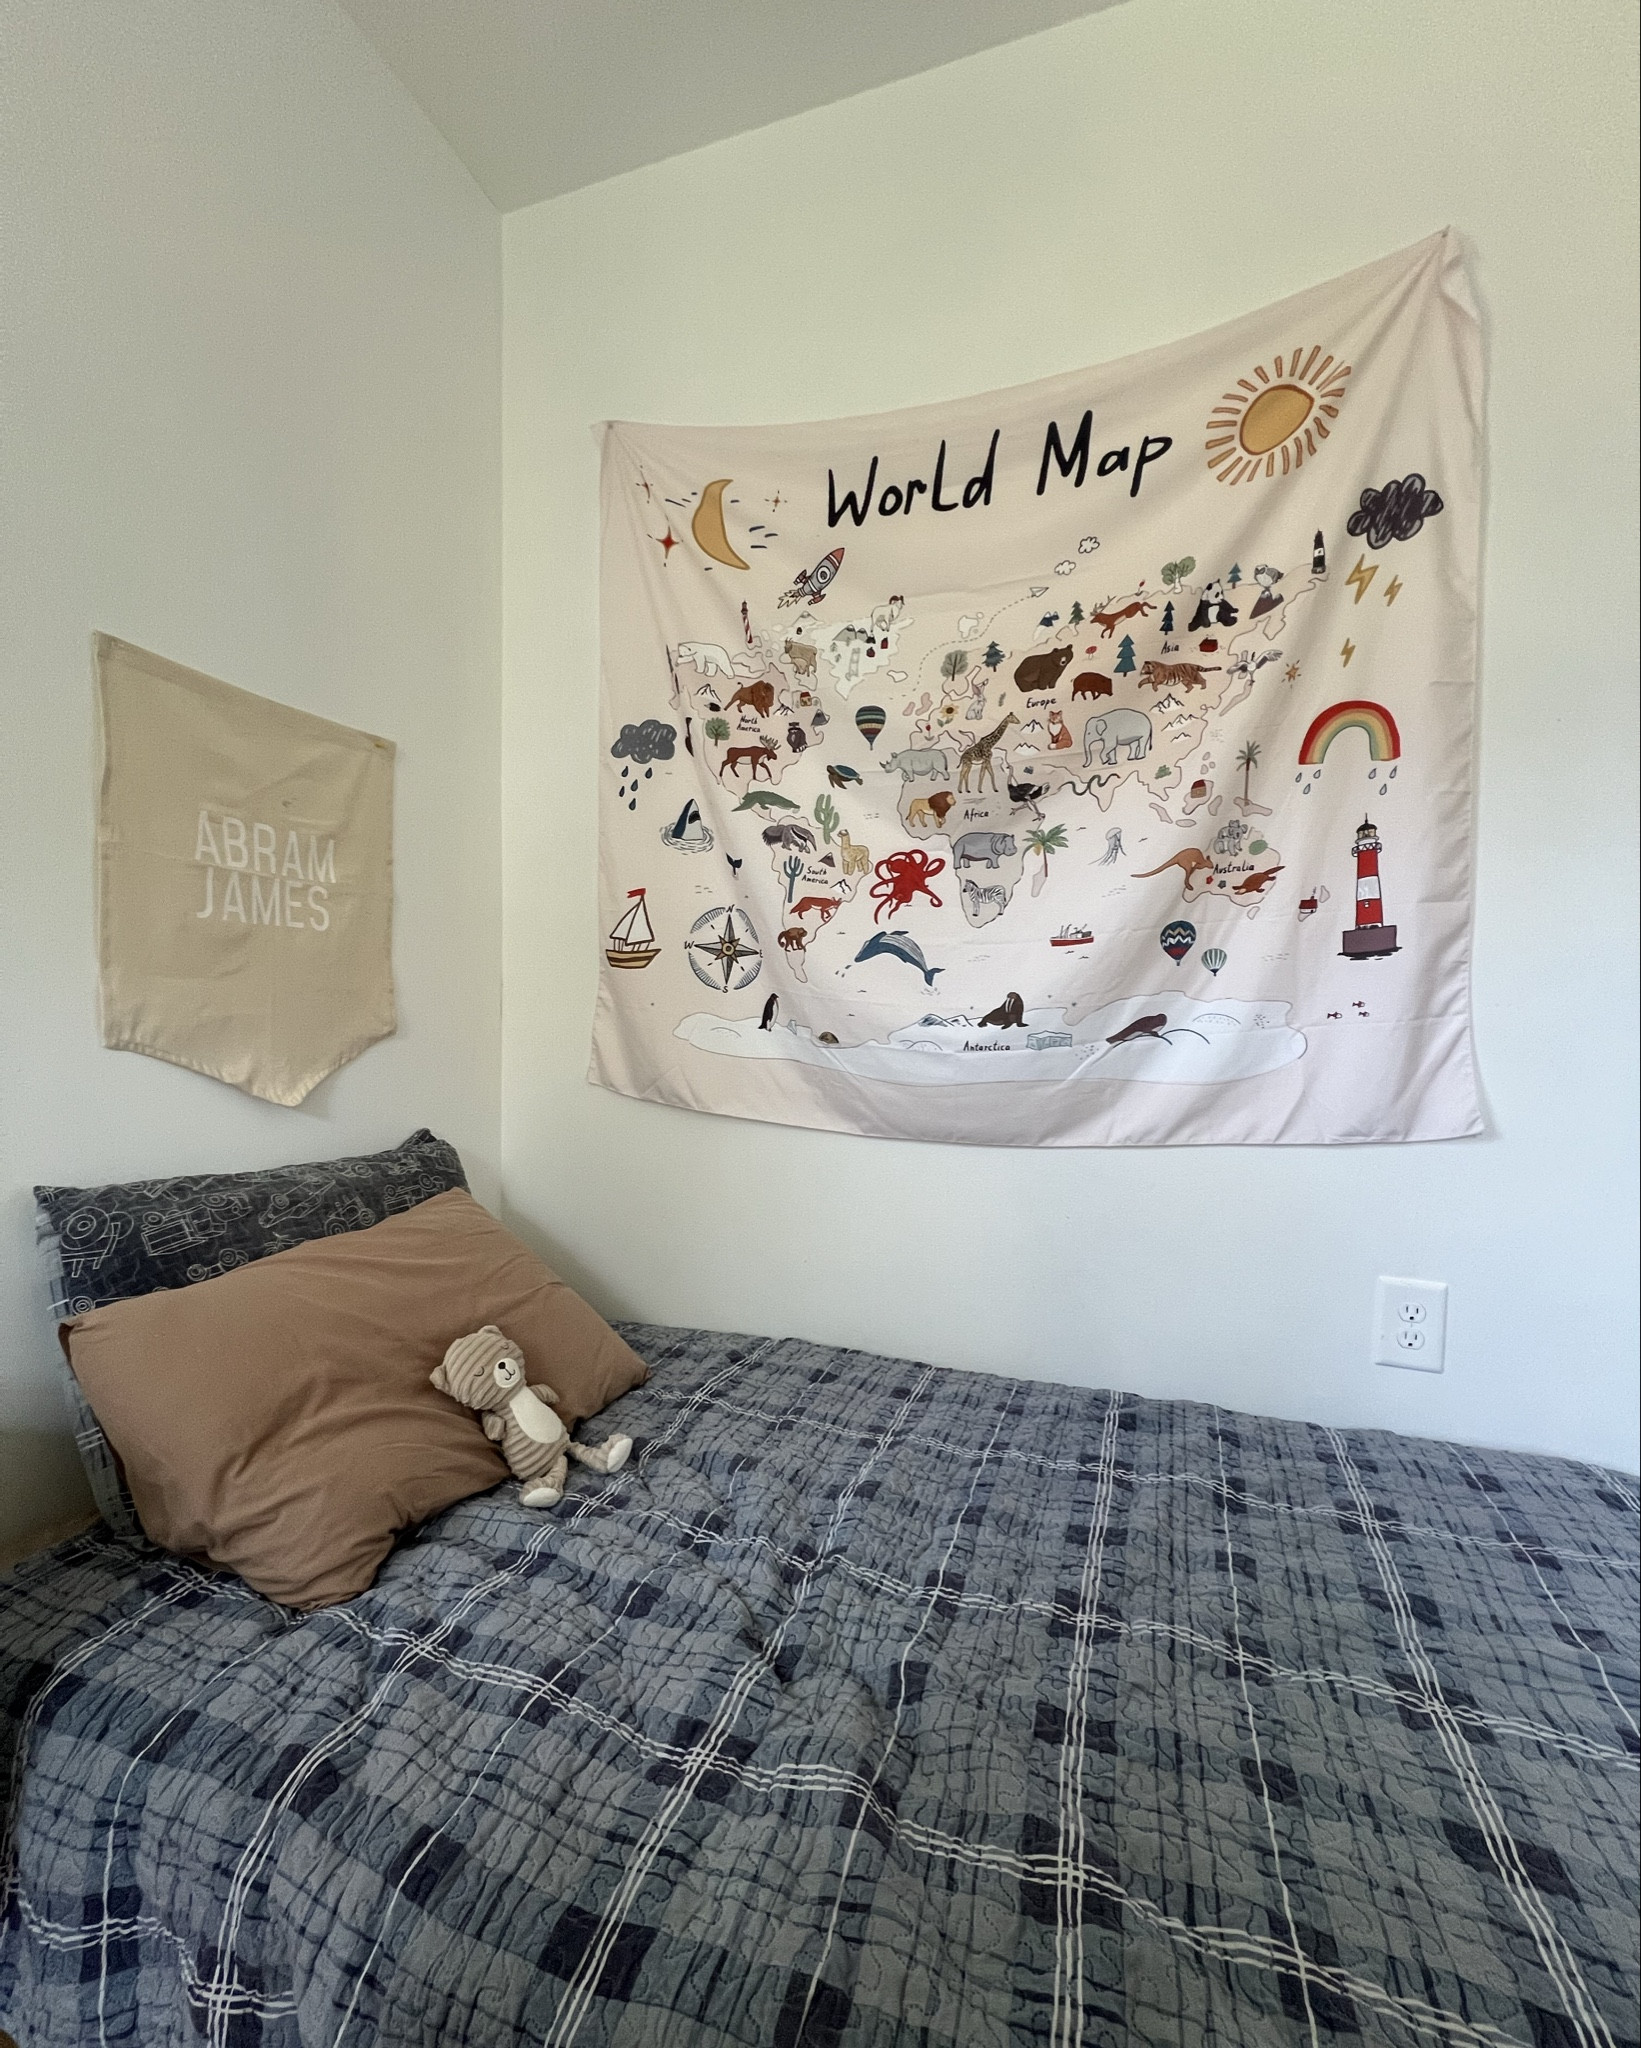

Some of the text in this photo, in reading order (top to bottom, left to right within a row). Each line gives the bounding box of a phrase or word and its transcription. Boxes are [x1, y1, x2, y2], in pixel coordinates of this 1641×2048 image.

[1036, 410, 1173, 498] Map
[1160, 640, 1180, 655] Asia
[1026, 697, 1057, 710] Europe
[963, 808, 990, 822] Africa
[195, 810, 337, 884] ABRAM
[806, 865, 828, 876] South
[1212, 859, 1255, 875] Australia
[801, 874, 829, 885] America
[196, 867, 330, 932] JAMES
[725, 904, 735, 914] N
[683, 940, 695, 950] W
[721, 985, 729, 994] S
[962, 1040, 1011, 1052] Antarctica
